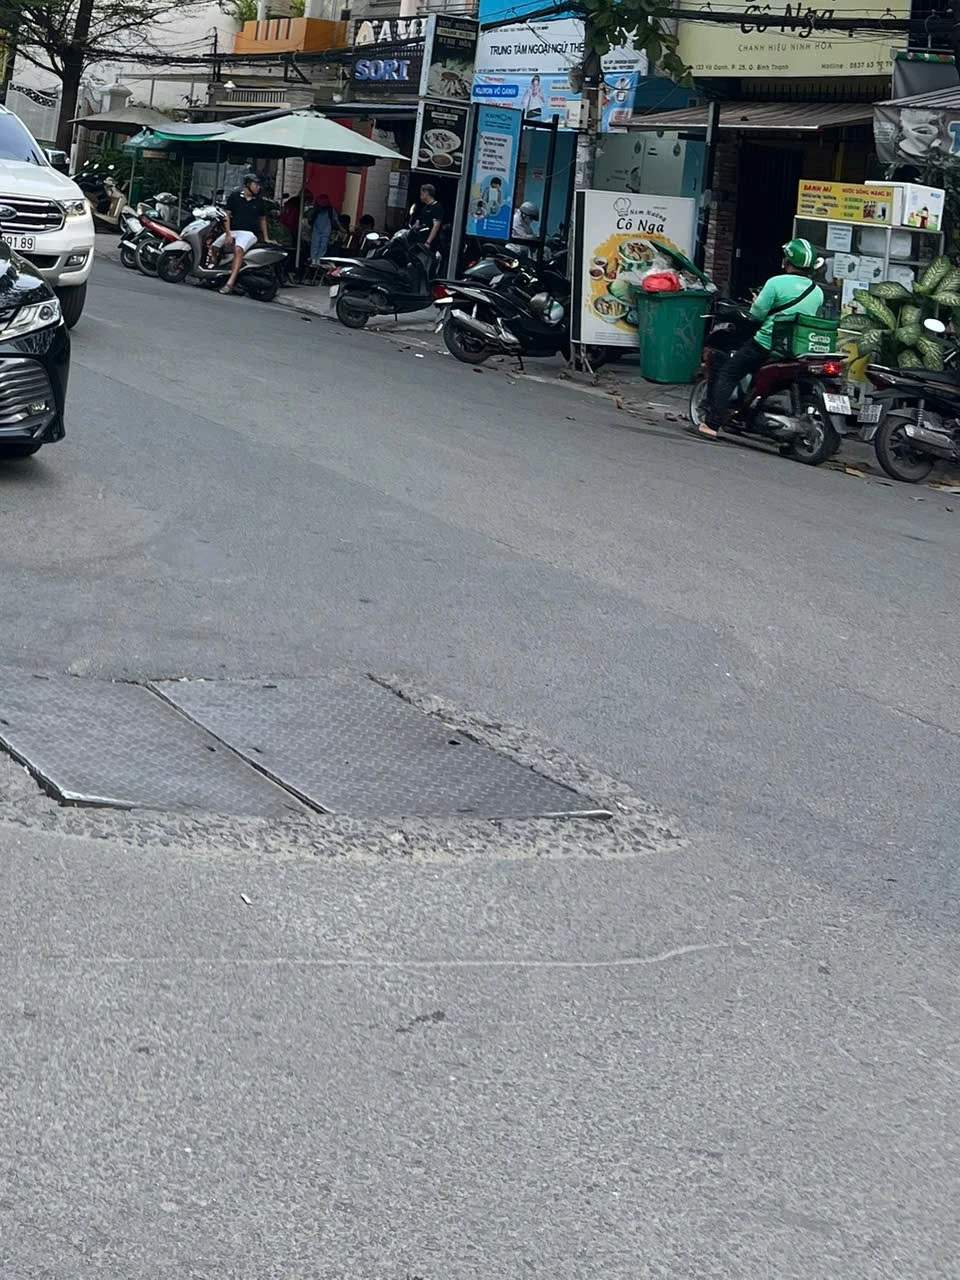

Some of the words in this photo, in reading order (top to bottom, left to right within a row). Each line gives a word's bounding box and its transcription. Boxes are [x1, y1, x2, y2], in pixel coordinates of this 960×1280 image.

[490, 45, 512, 56] TRUNG
[569, 42, 585, 53] THE
[791, 42, 811, 51] NINH
[354, 59, 411, 81] SORI
[616, 217, 633, 231] Cô
[637, 219, 665, 235] Nga
